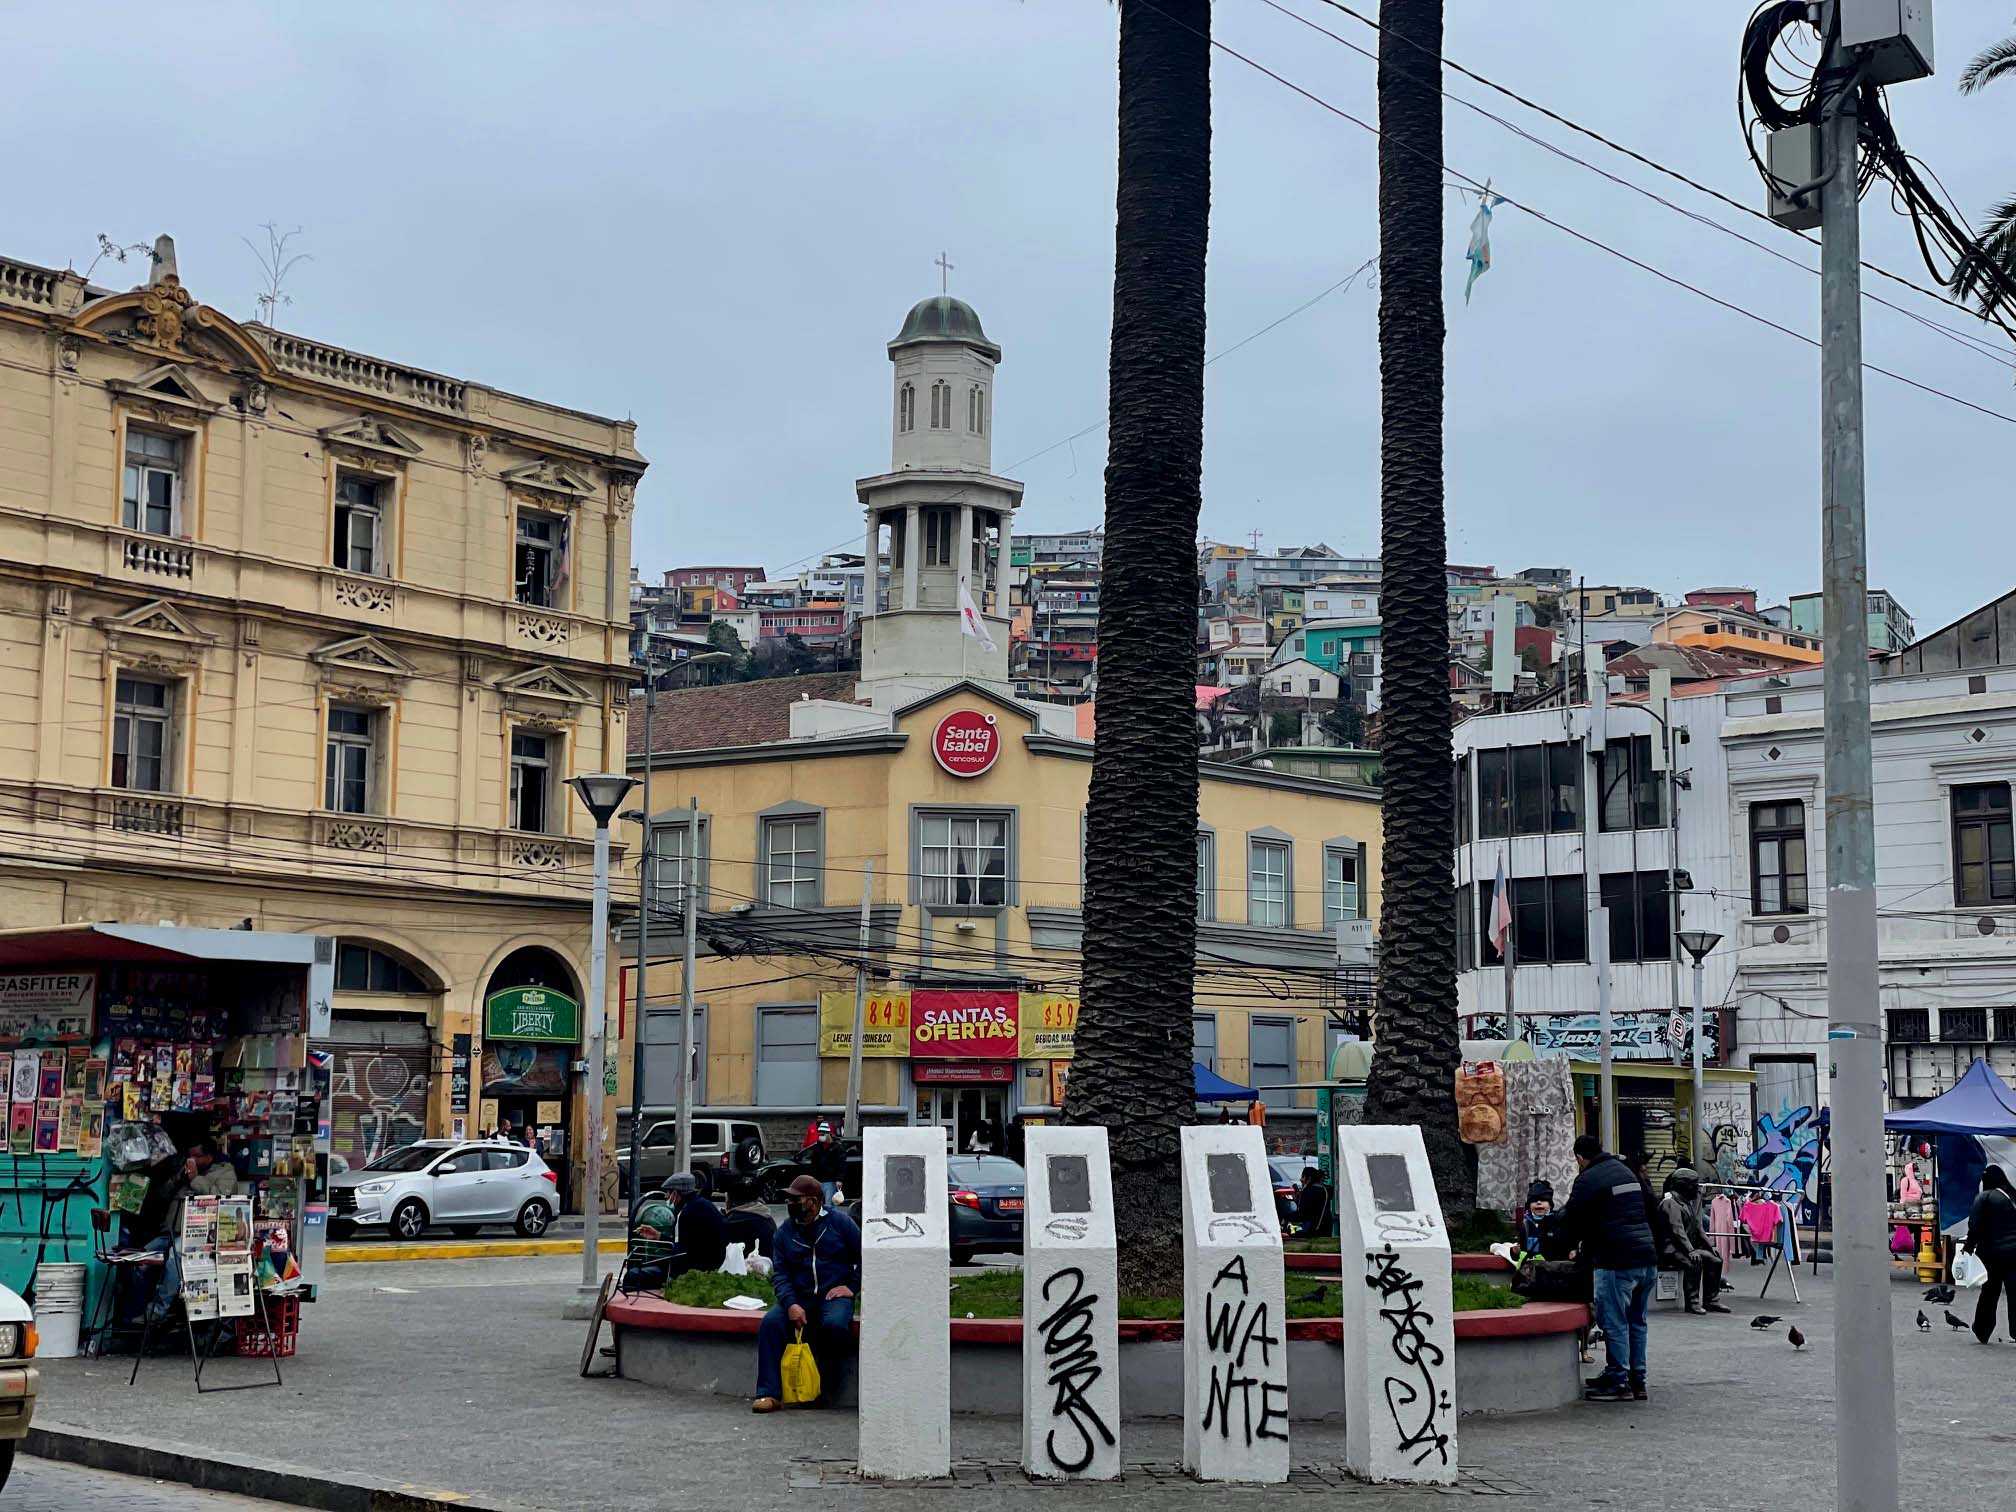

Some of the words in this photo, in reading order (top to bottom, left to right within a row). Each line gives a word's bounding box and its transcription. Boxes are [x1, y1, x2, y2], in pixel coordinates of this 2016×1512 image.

[945, 726, 991, 739] Santa
[943, 739, 989, 752] Isabel
[512, 1012, 554, 1033] LIBERTY
[924, 1006, 1007, 1026] SANTAS
[1213, 1255, 1248, 1295] A
[1206, 1292, 1278, 1367] WA
[1203, 1362, 1288, 1447] NTE
